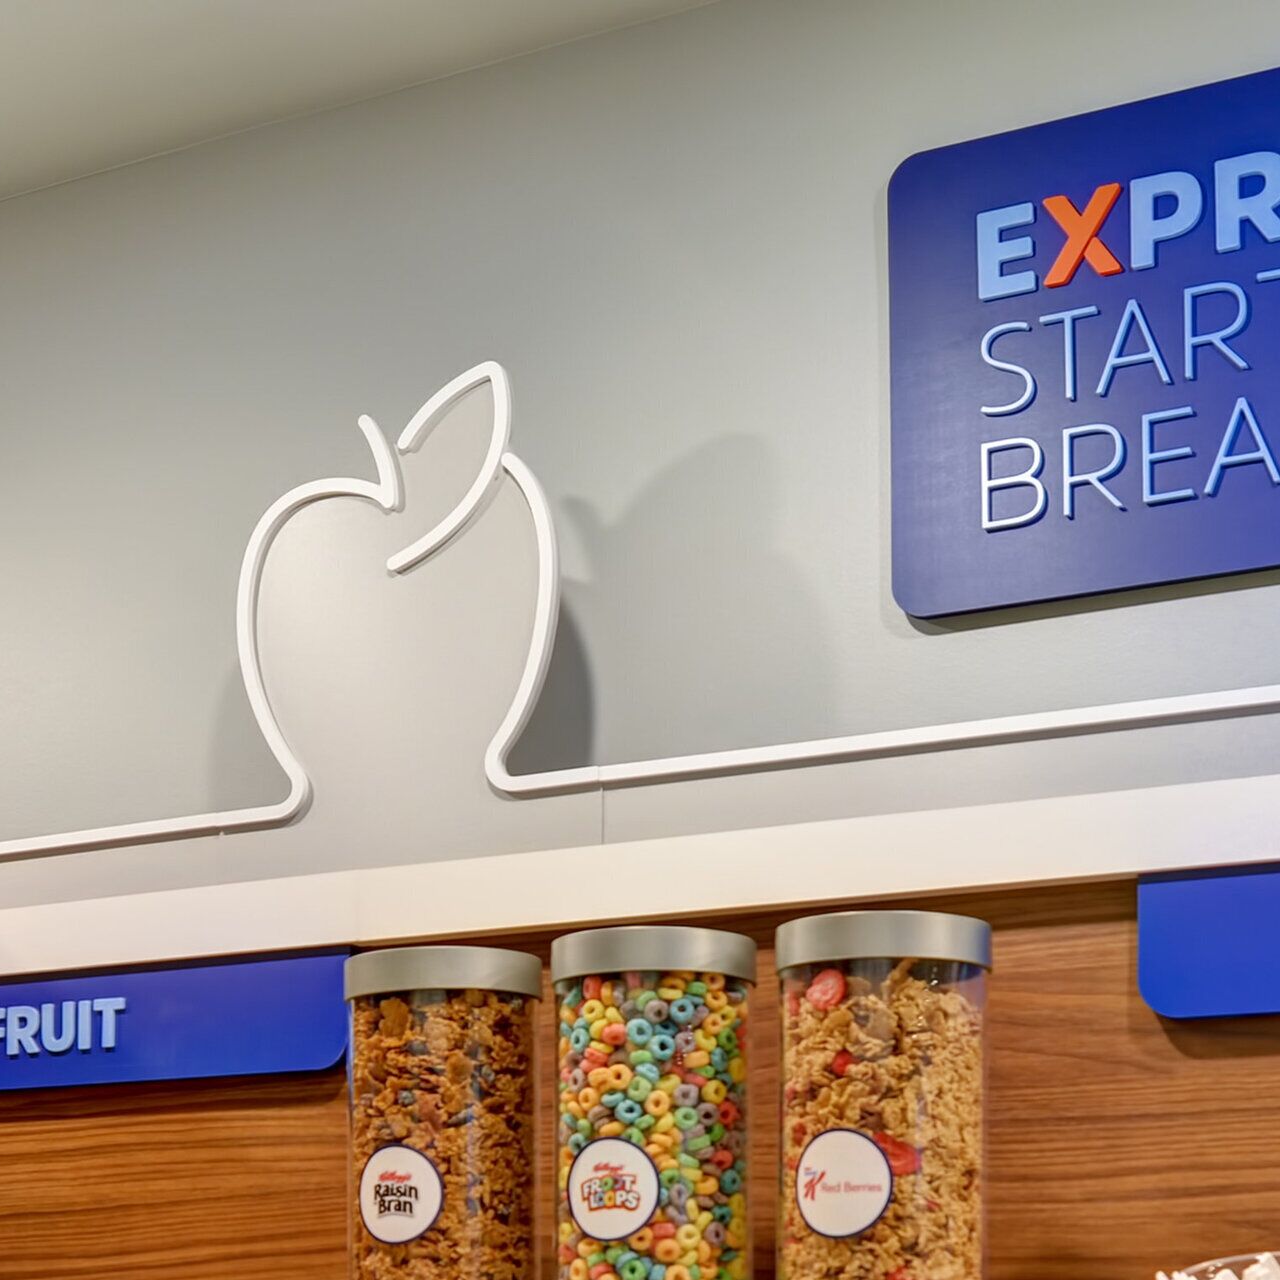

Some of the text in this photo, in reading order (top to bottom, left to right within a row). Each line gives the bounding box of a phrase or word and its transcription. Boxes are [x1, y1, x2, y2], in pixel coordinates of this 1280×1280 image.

[373, 1183, 419, 1202] Raisin
[843, 1181, 882, 1193] Berries
[378, 1199, 414, 1215] Bran
[588, 1189, 641, 1212] LOOPS
